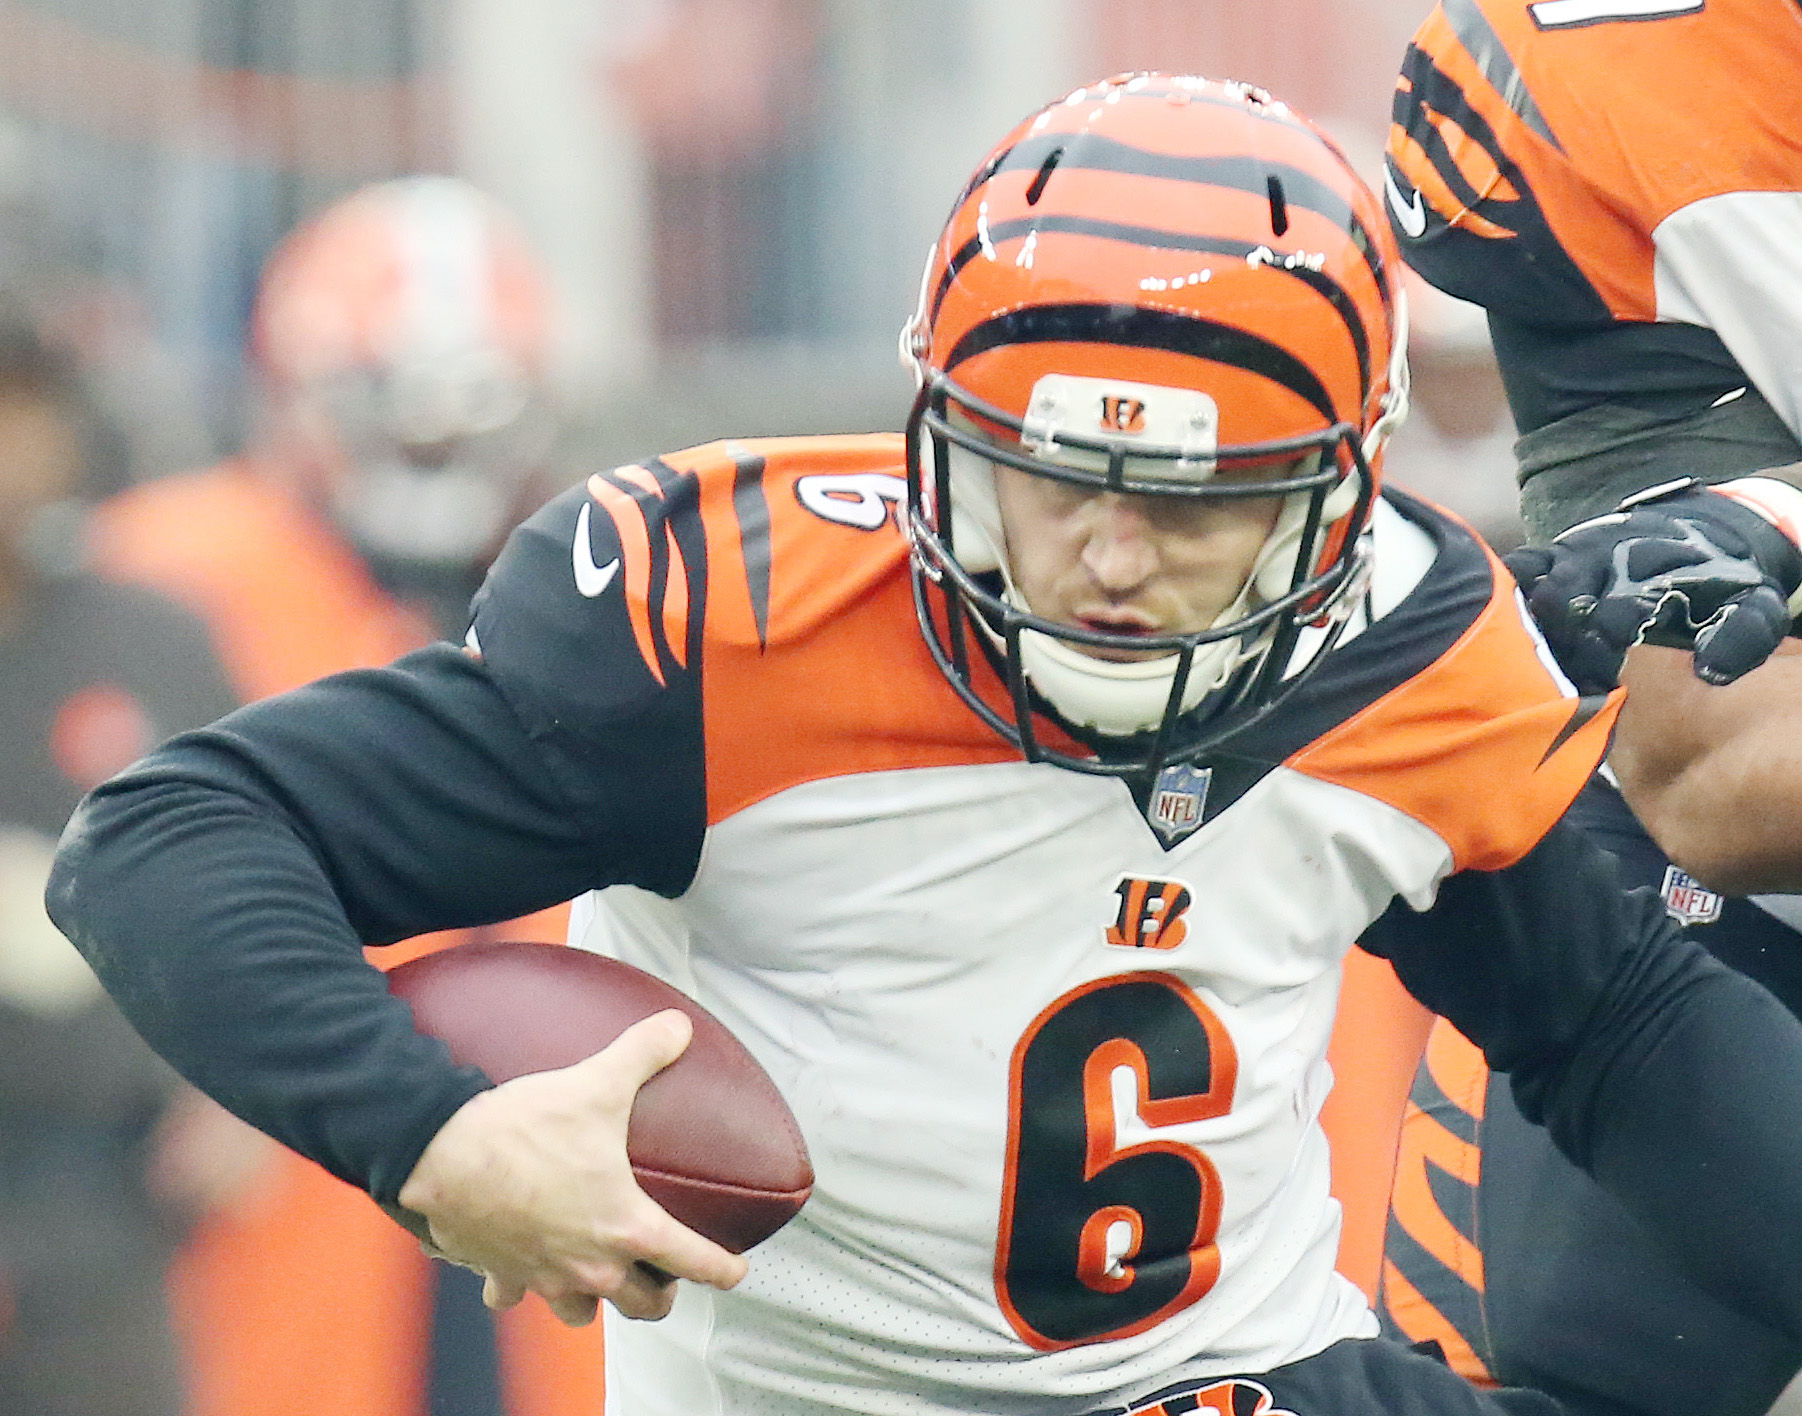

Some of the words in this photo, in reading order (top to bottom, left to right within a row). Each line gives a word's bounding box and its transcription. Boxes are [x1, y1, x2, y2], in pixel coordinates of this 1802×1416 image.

[1158, 795, 1196, 823] NFL
[1672, 888, 1712, 913] NFL
[993, 969, 1239, 1352] 6
